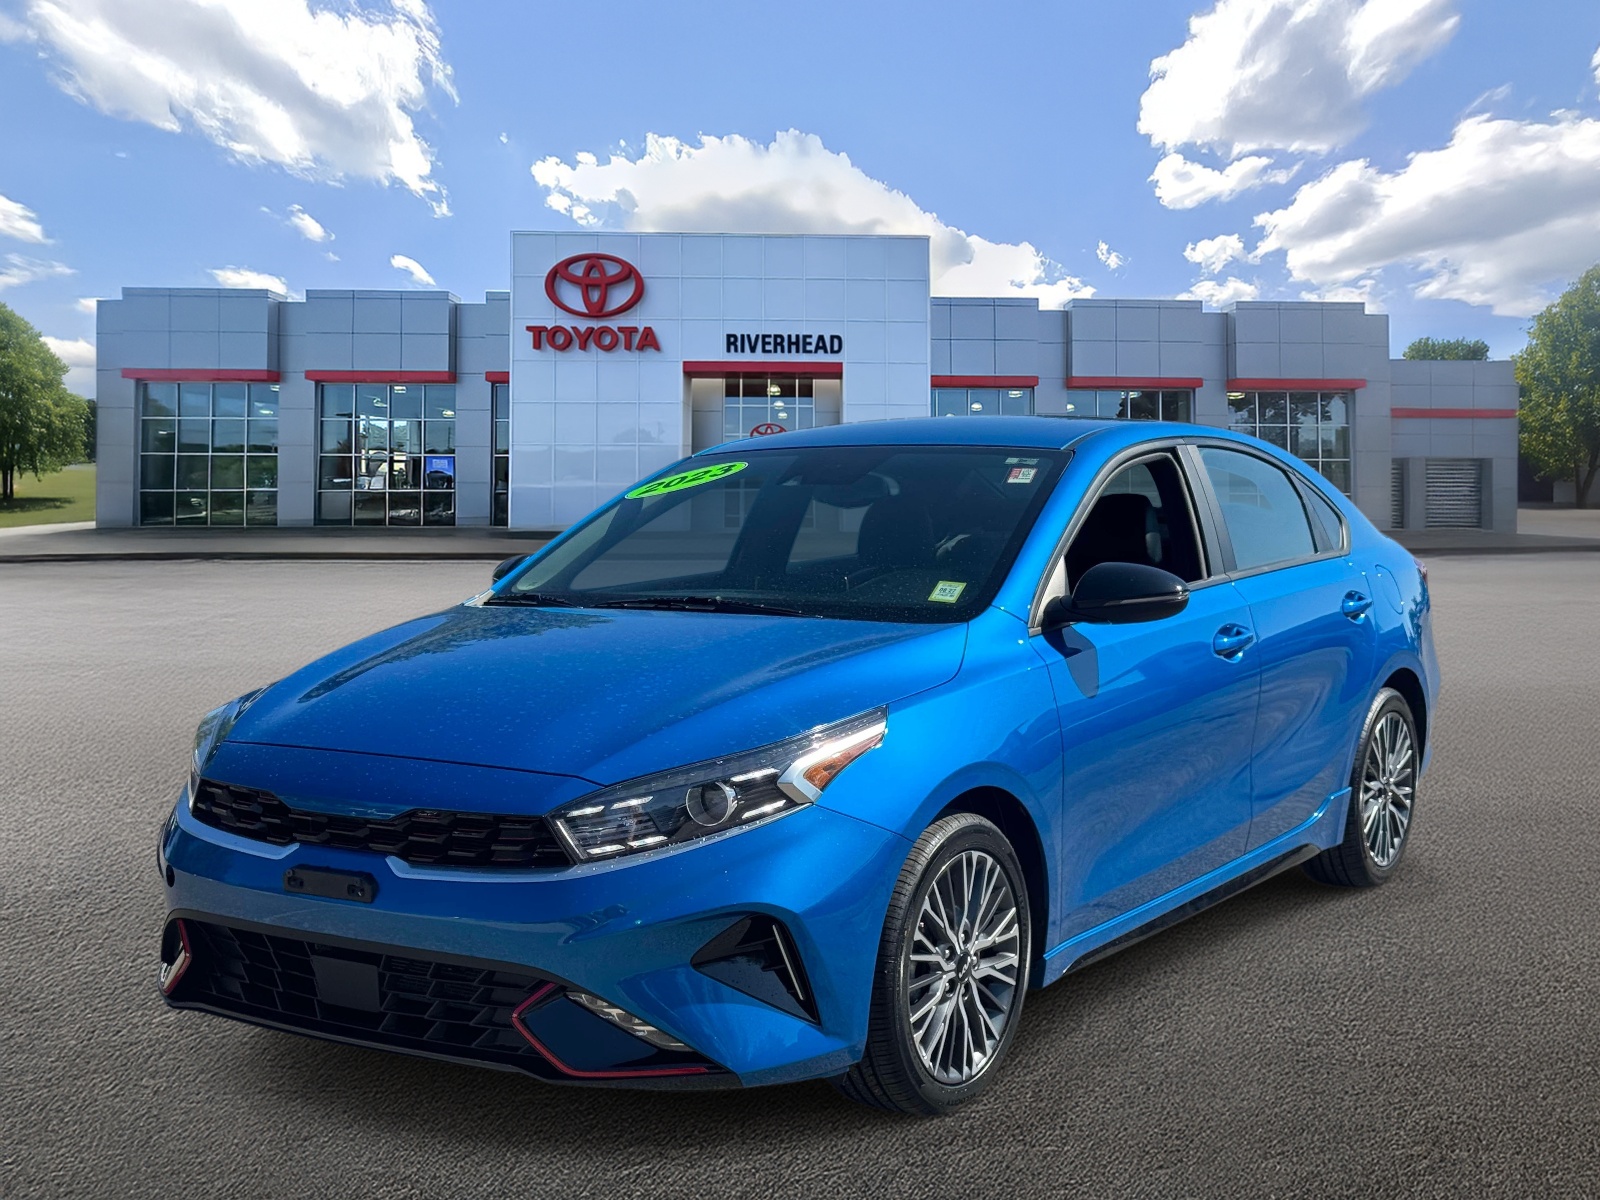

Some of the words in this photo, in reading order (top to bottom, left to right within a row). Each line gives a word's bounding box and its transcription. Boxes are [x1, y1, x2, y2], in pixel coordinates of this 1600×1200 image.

[526, 325, 661, 351] TOYOTA
[726, 333, 843, 354] RIVERHEAD
[636, 464, 737, 496] 2023
